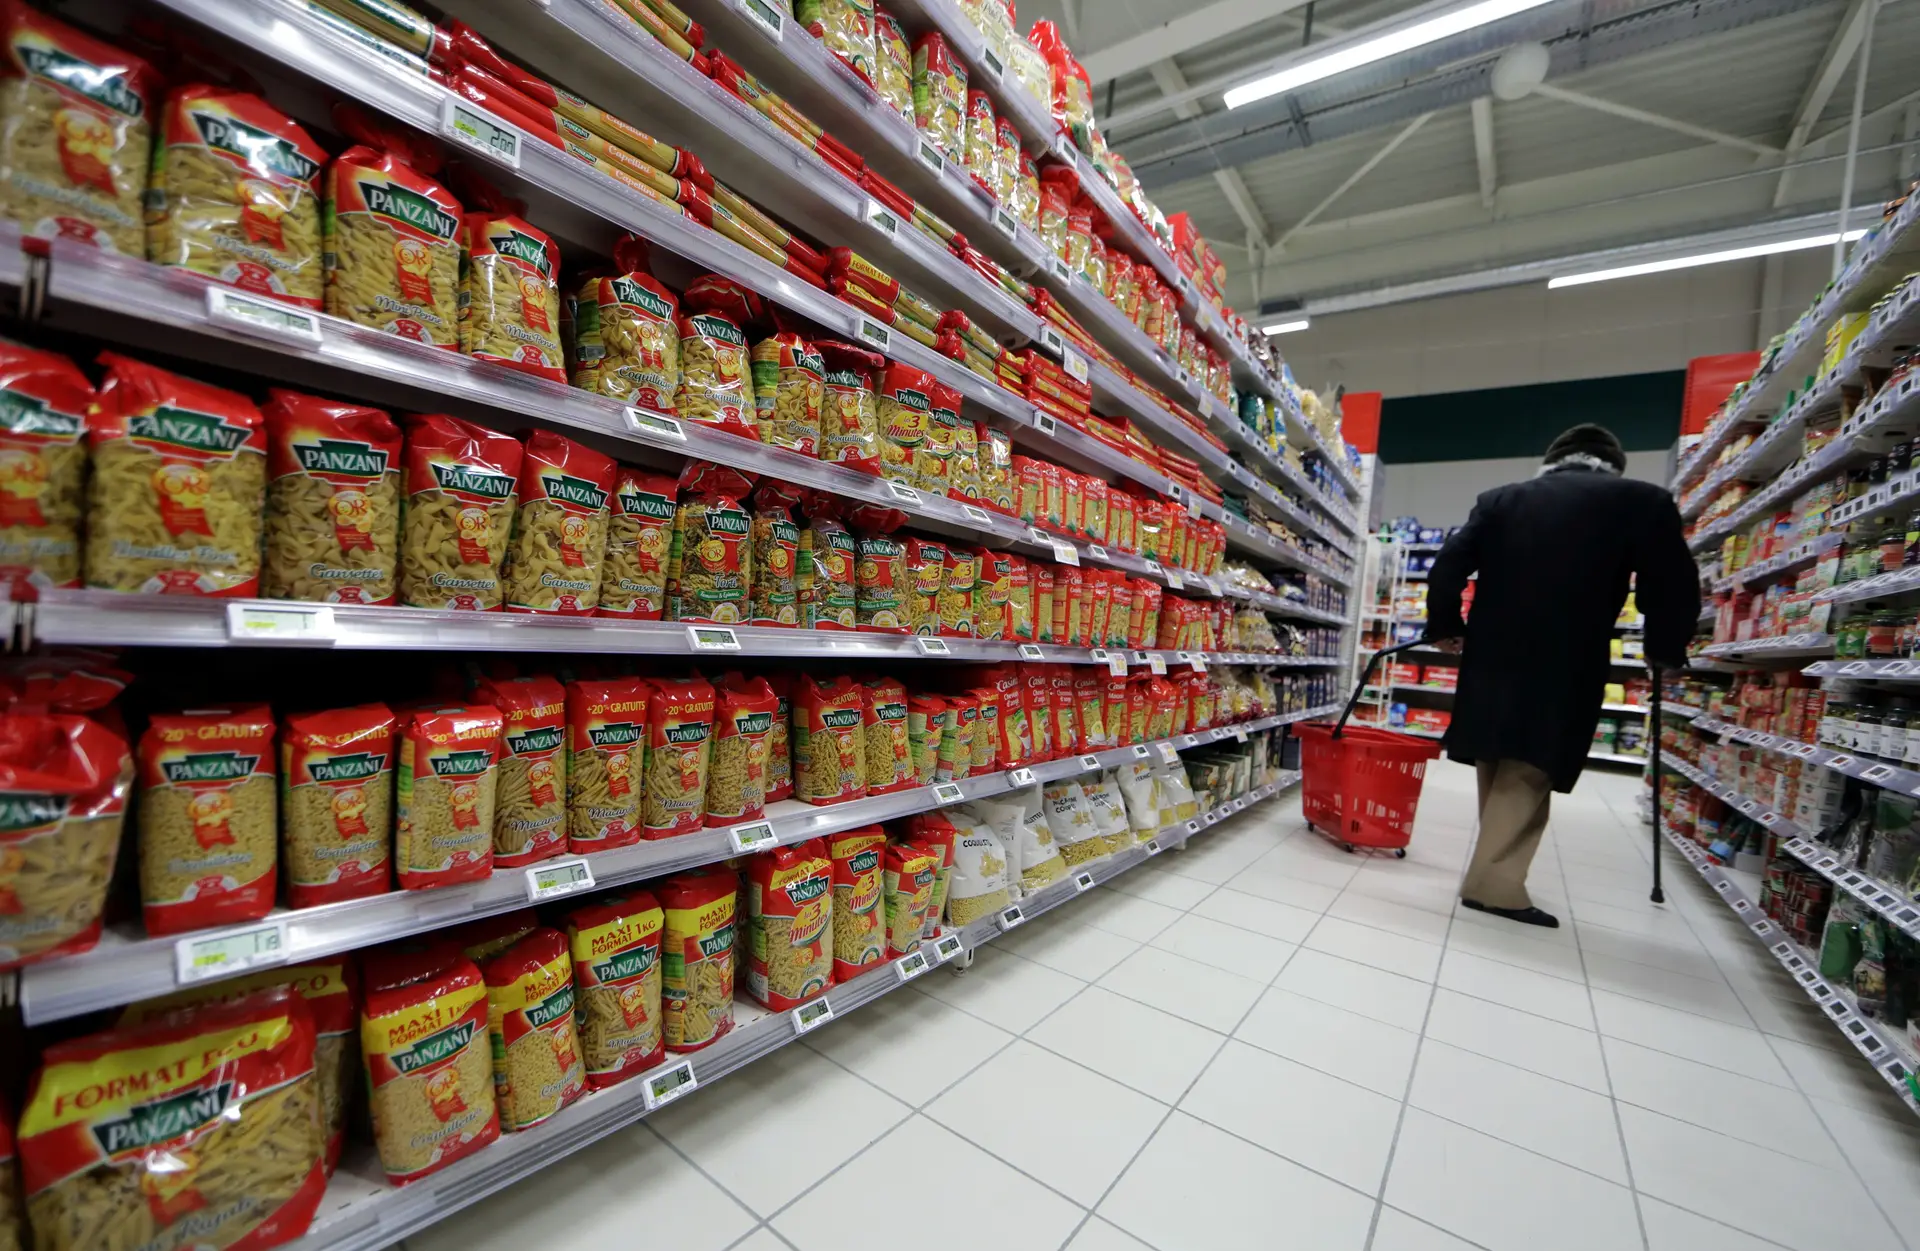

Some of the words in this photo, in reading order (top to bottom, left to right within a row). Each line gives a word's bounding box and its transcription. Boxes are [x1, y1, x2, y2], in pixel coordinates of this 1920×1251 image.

[606, 113, 649, 141] Capellini
[771, 105, 801, 132] Capellini
[563, 120, 590, 139] PANZANI
[207, 121, 311, 179] PAZANI
[572, 146, 597, 164] PANZANI
[608, 145, 651, 175] Capellini
[615, 169, 657, 198] Capellini
[370, 190, 450, 239] PANZANI
[399, 249, 427, 266] OR
[500, 240, 552, 282] PANZA
[852, 260, 877, 277] FORMAT
[876, 271, 890, 283] ECO
[524, 282, 544, 301] OR
[375, 295, 408, 315] Mini
[411, 305, 442, 325] Penne
[620, 284, 672, 322] PANZANI
[506, 324, 532, 342] Mini
[700, 320, 742, 344] PANZANI
[618, 367, 676, 392] Coquillages
[825, 370, 863, 388] PANZANI
[899, 393, 929, 409] PANZANI
[887, 423, 924, 438] Minutes
[911, 415, 921, 428] 3
[128, 414, 238, 450] PANZANI
[943, 431, 950, 443] 3
[966, 431, 973, 442] 3
[304, 450, 384, 474] PANZANI
[441, 470, 510, 497] PANZANI
[549, 482, 602, 508] PANZANI
[625, 497, 674, 520] PANZANI
[460, 516, 487, 532] OR
[564, 523, 586, 538] OR
[711, 516, 749, 533] PANZANI
[706, 549, 722, 558] OR
[862, 542, 899, 556] PANZANI
[310, 563, 385, 582] Gansettes
[432, 571, 497, 591] Gansettes
[714, 574, 738, 589] Torti
[931, 566, 940, 579] 3
[966, 566, 972, 578] 3
[541, 573, 592, 592] Gansettes
[619, 578, 663, 595] Gansettes
[871, 588, 894, 600] Torti
[504, 708, 530, 721] +20%
[586, 704, 610, 715] +20%
[610, 700, 646, 714] GRATUITS
[664, 705, 684, 716] +20%
[684, 701, 714, 714] GRATUITS
[880, 704, 907, 719] PANZANI
[740, 713, 772, 732] PANZANI
[826, 712, 860, 728] PANZANI
[197, 723, 264, 740] GRATUITS
[336, 727, 389, 744] GRATUITS
[456, 726, 501, 740] GRATUITS
[595, 727, 640, 745] PANZANI
[670, 725, 711, 744] PANZANI
[514, 731, 562, 754] PANZANI
[838, 739, 853, 750] OR
[170, 759, 250, 779] PANZANI
[315, 759, 380, 780] PANZANI
[609, 760, 629, 773] OR
[682, 756, 699, 769] OR
[531, 766, 552, 780] OR
[588, 803, 636, 819] Macaroni
[511, 812, 563, 832] Macaroni
[841, 843, 866, 856] FORMAT
[853, 855, 878, 872] PANZANI
[778, 866, 811, 885] FORMAT
[867, 875, 875, 888] 3
[792, 880, 828, 902] PANZANI
[850, 886, 881, 911] Minutes
[924, 888, 931, 900] 3
[700, 903, 727, 923] MAXI
[700, 912, 727, 931] FORMAT
[810, 903, 822, 921] 3
[592, 924, 631, 948] MAXI
[635, 920, 656, 935] 1KG
[789, 913, 828, 943] Minutes
[592, 932, 633, 956] FORMAT
[601, 951, 654, 981] PANZANI
[525, 971, 558, 992] MAXI
[526, 978, 560, 1003] FORMAT
[534, 992, 575, 1026] PANZAN
[389, 1008, 441, 1037] MAXI
[390, 1017, 442, 1048] FORMAT
[402, 1028, 469, 1072] PANZANI
[54, 1058, 191, 1119] FORMAT
[107, 1091, 222, 1151] PANZANI
